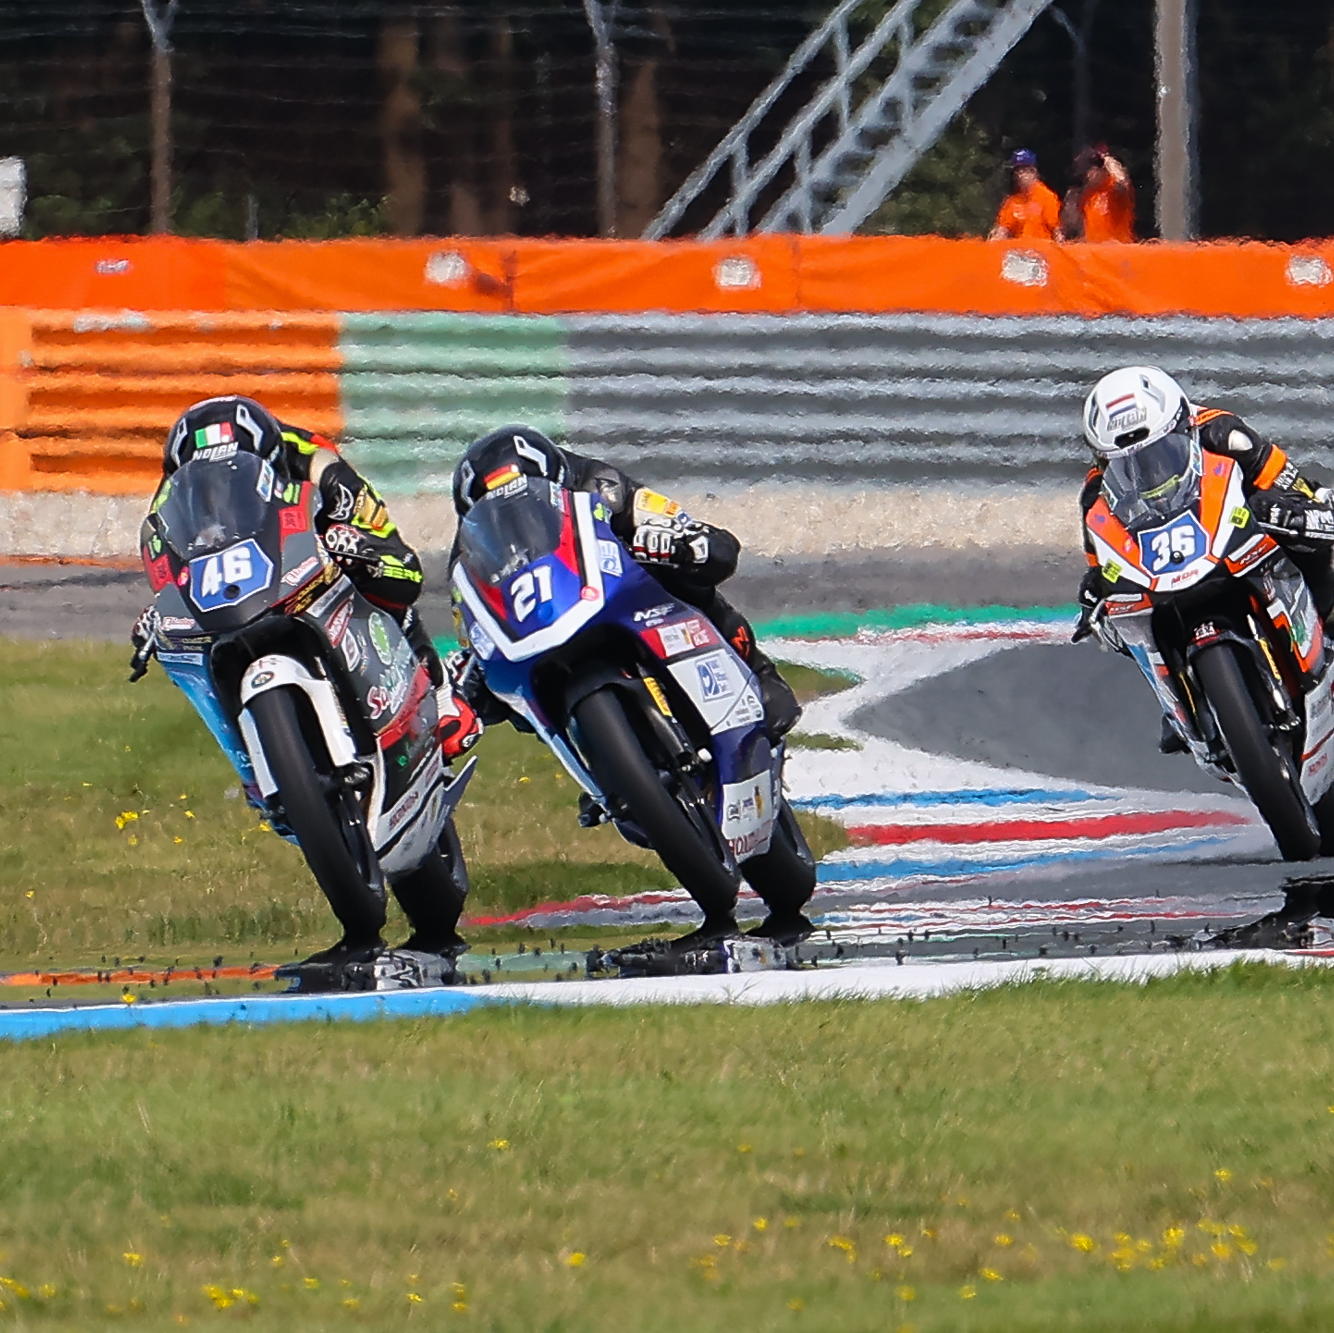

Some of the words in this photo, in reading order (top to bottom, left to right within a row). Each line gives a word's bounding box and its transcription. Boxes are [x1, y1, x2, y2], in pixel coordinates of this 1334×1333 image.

[192, 442, 239, 462] NOLAN
[486, 474, 529, 499] NOLAN
[201, 546, 253, 598] 46
[1151, 525, 1196, 572] 36
[510, 565, 553, 623] 21
